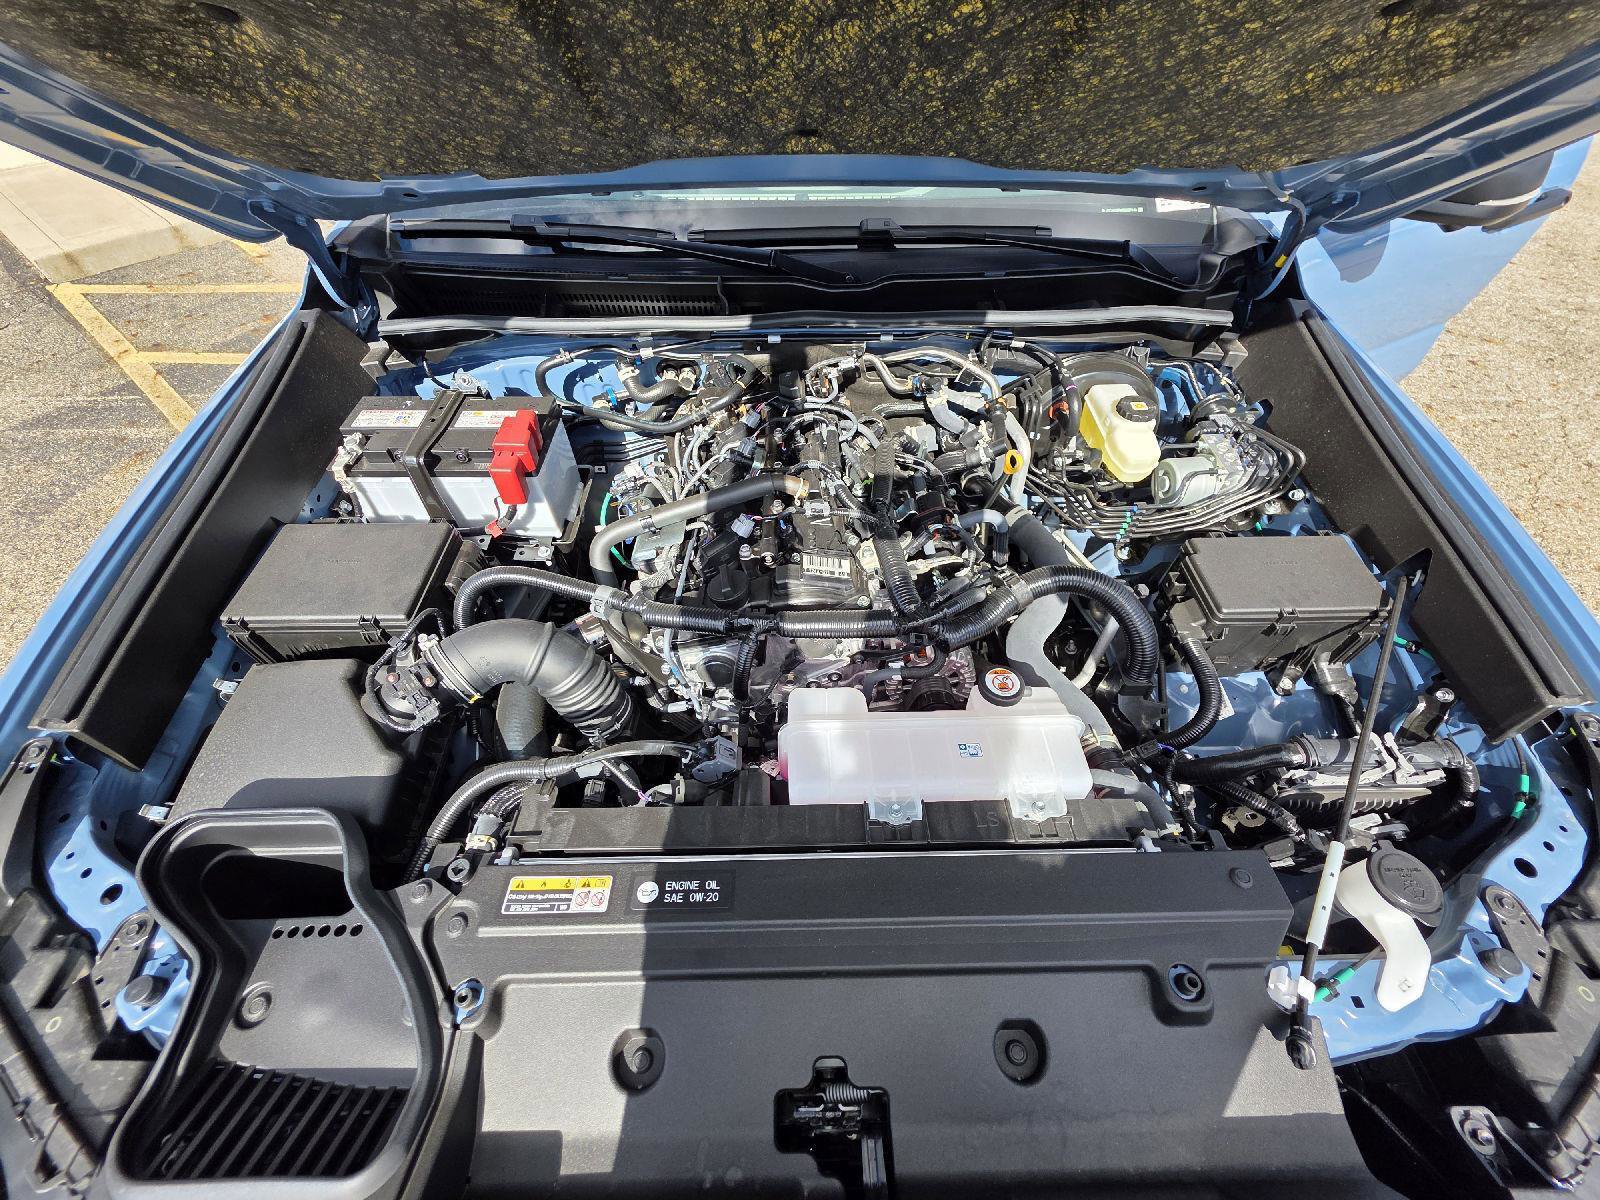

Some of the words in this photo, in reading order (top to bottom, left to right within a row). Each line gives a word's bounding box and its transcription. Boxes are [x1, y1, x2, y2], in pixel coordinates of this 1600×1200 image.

[665, 880, 701, 891] ENGINE
[705, 880, 721, 890] OIL
[663, 893, 685, 903] SAE
[689, 892, 719, 902] 0W-20
